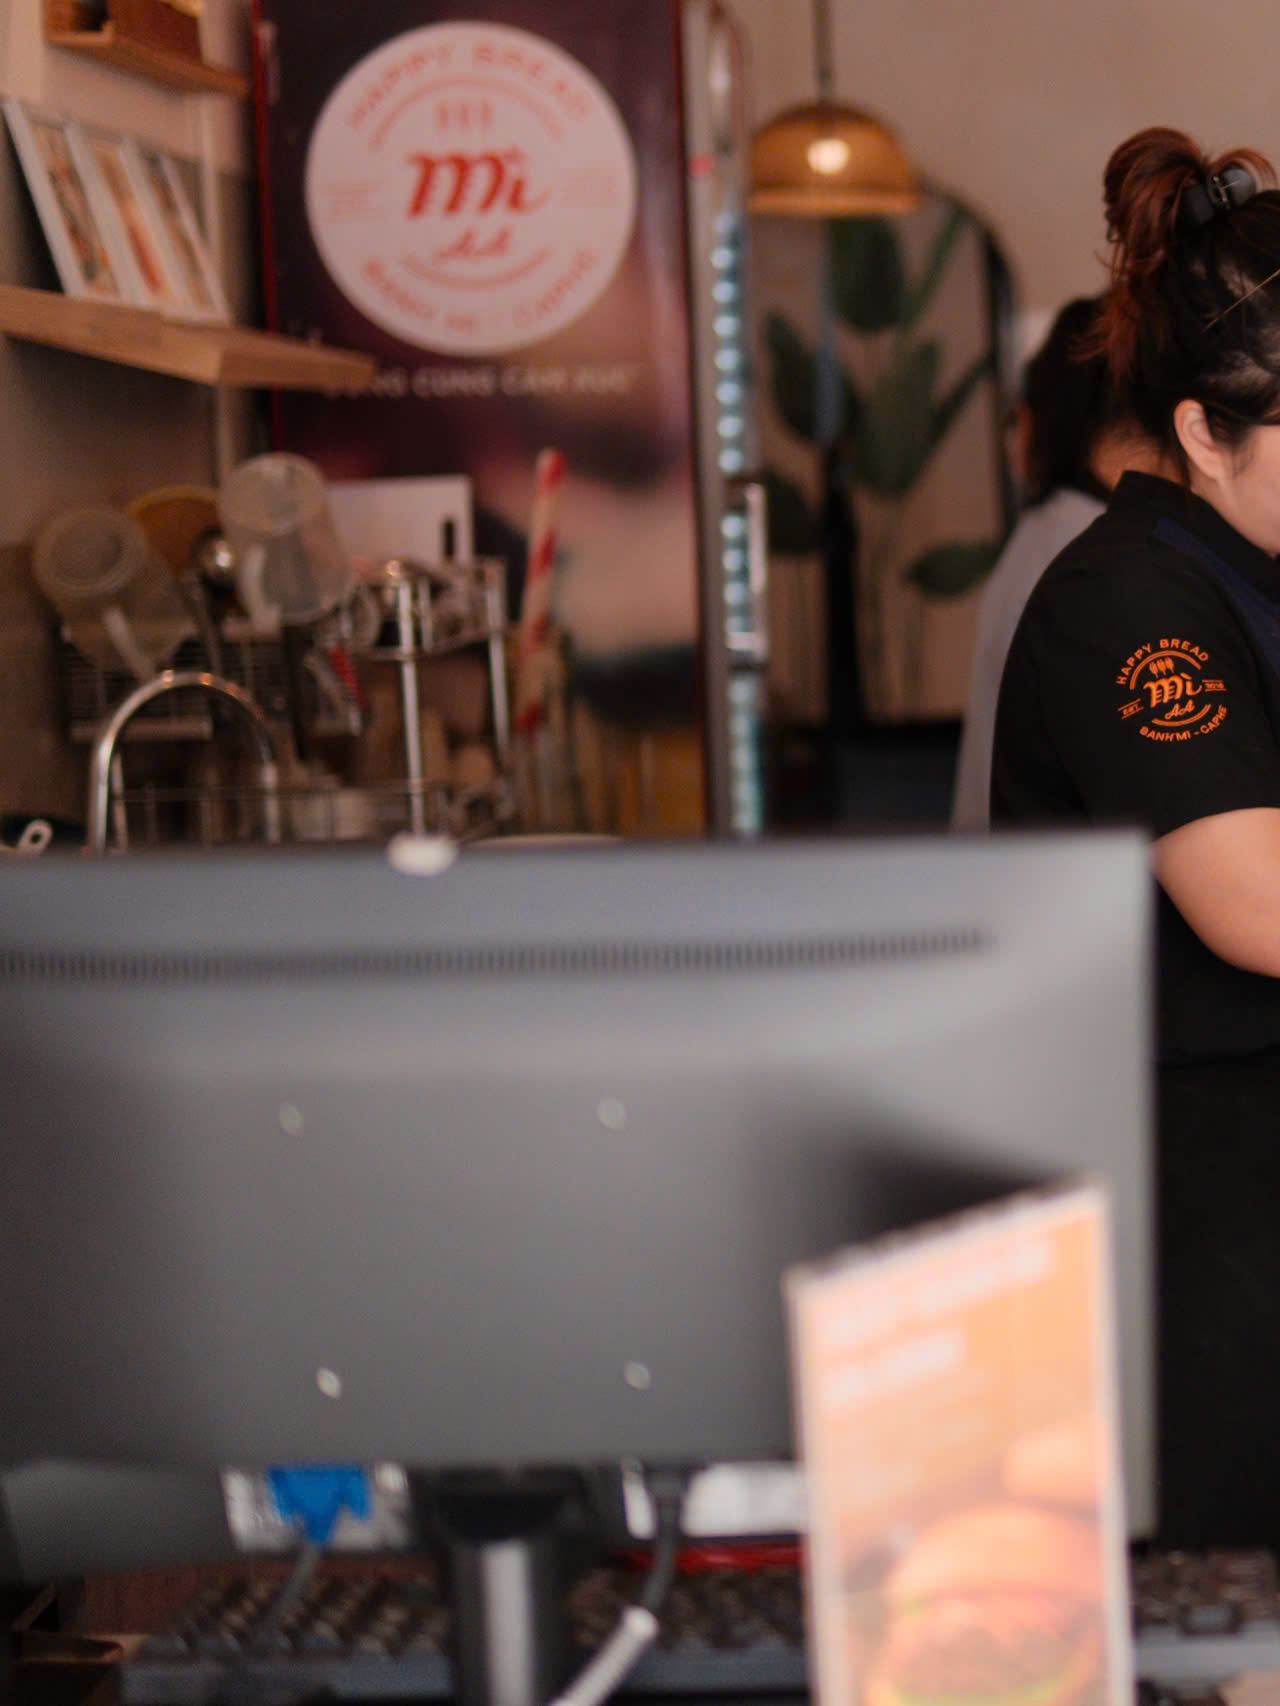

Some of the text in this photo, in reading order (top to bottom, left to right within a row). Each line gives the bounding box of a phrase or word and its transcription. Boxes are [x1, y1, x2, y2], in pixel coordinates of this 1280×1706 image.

[1116, 638, 1209, 685] HAPPY BREAD
[1200, 704, 1228, 734] CAPHE
